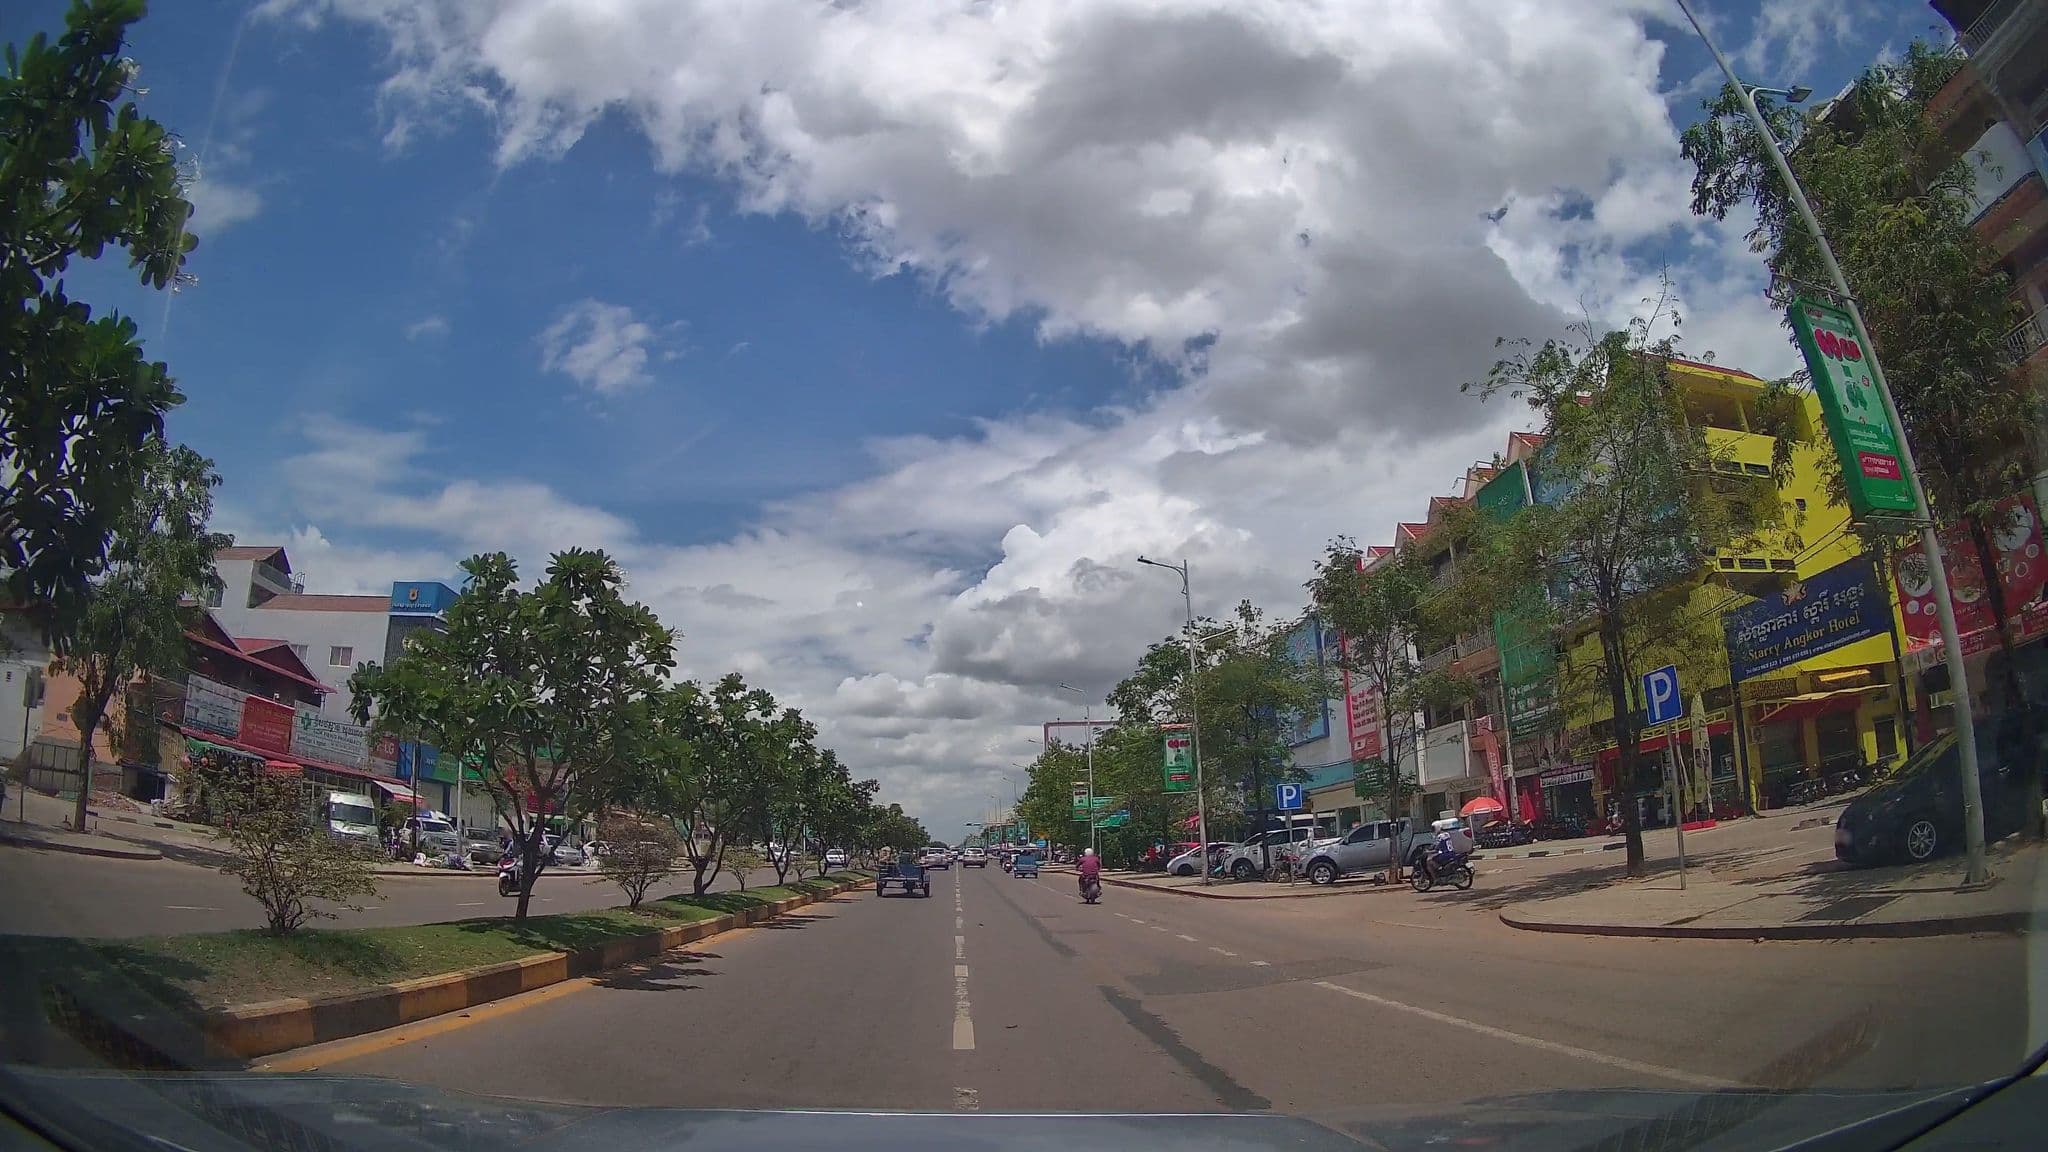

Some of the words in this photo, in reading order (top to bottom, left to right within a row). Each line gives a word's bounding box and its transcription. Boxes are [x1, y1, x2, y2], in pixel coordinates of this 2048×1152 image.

[1748, 642, 1781, 661] Starry
[1784, 628, 1825, 649] Angkor
[1829, 611, 1861, 633] Hotel
[1649, 671, 1672, 720] P
[1282, 785, 1297, 808] P
